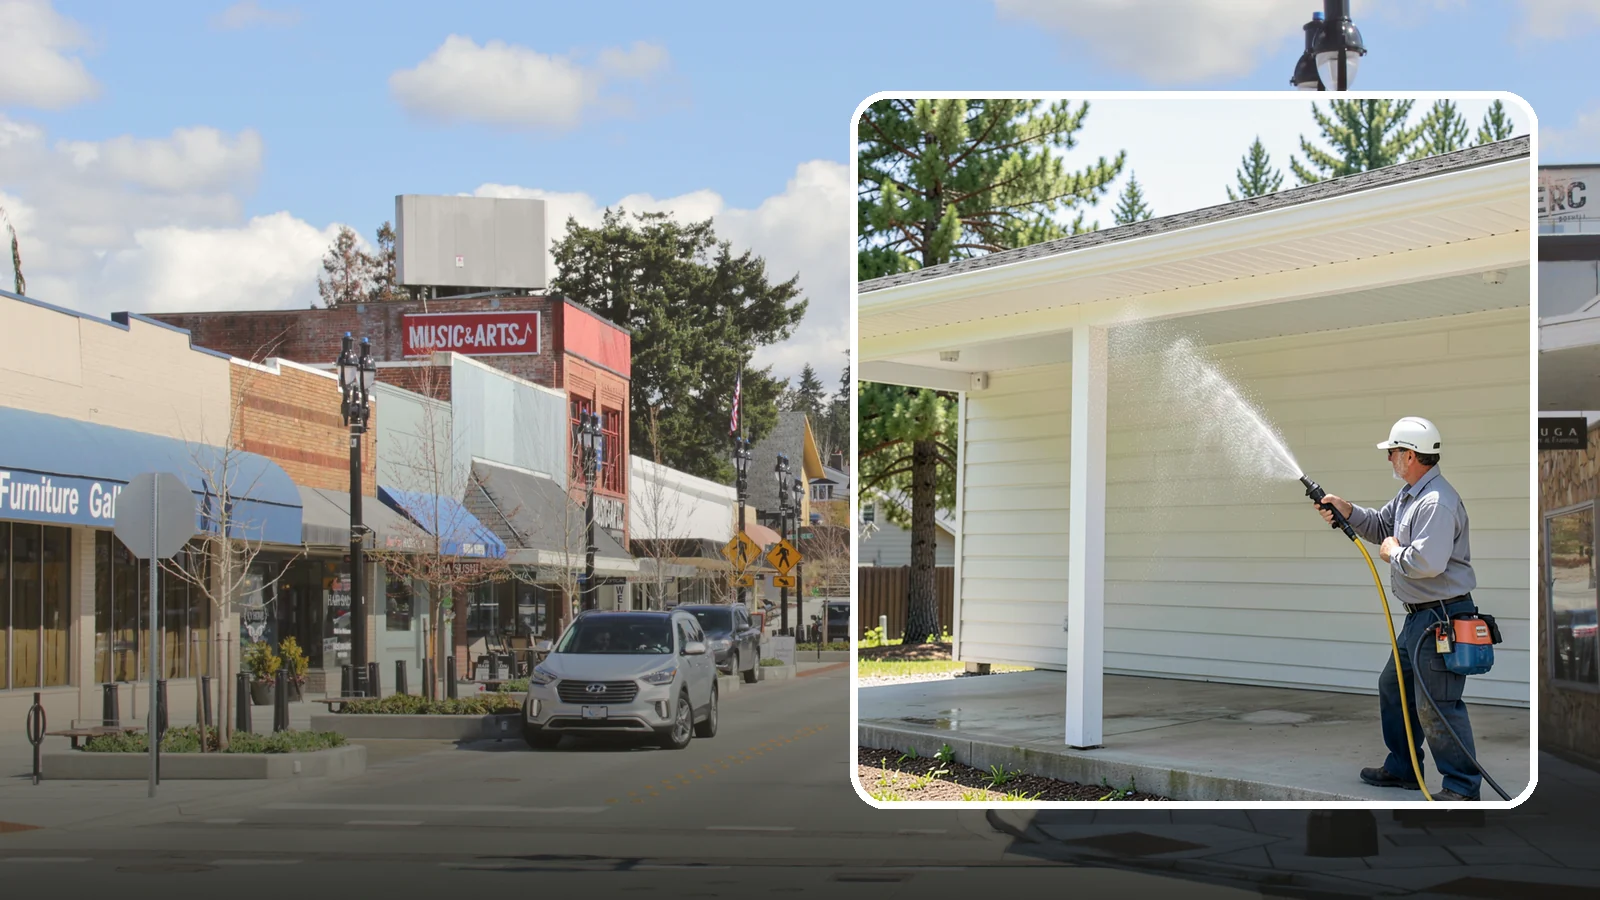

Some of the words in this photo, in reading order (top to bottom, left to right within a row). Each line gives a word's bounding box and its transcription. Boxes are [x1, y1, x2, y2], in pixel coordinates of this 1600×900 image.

[409, 323, 520, 349] MUSIC&ARTS
[0, 472, 79, 515] Furniture
[454, 563, 479, 574] SUSHI
